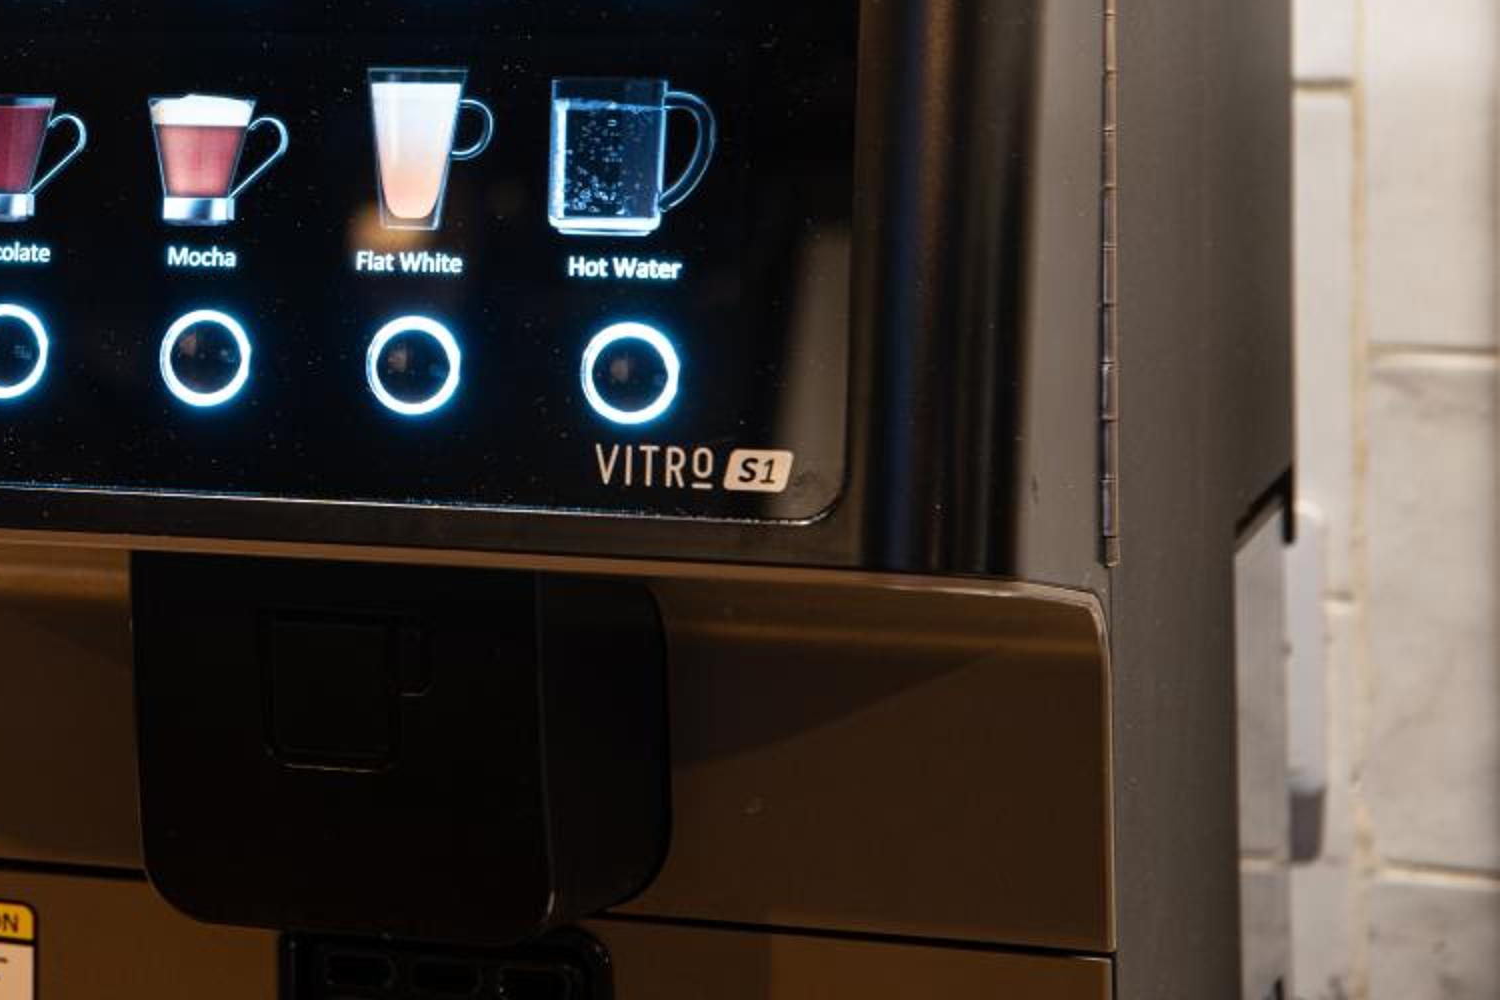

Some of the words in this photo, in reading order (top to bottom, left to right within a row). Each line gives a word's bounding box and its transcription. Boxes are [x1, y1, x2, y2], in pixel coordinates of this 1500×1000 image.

[167, 246, 237, 268] Mocha
[355, 251, 395, 272] Flat
[399, 251, 463, 274] White
[568, 256, 609, 278] Hot
[612, 257, 682, 280] Water
[596, 444, 712, 488] VITRO
[737, 457, 776, 485] S1
